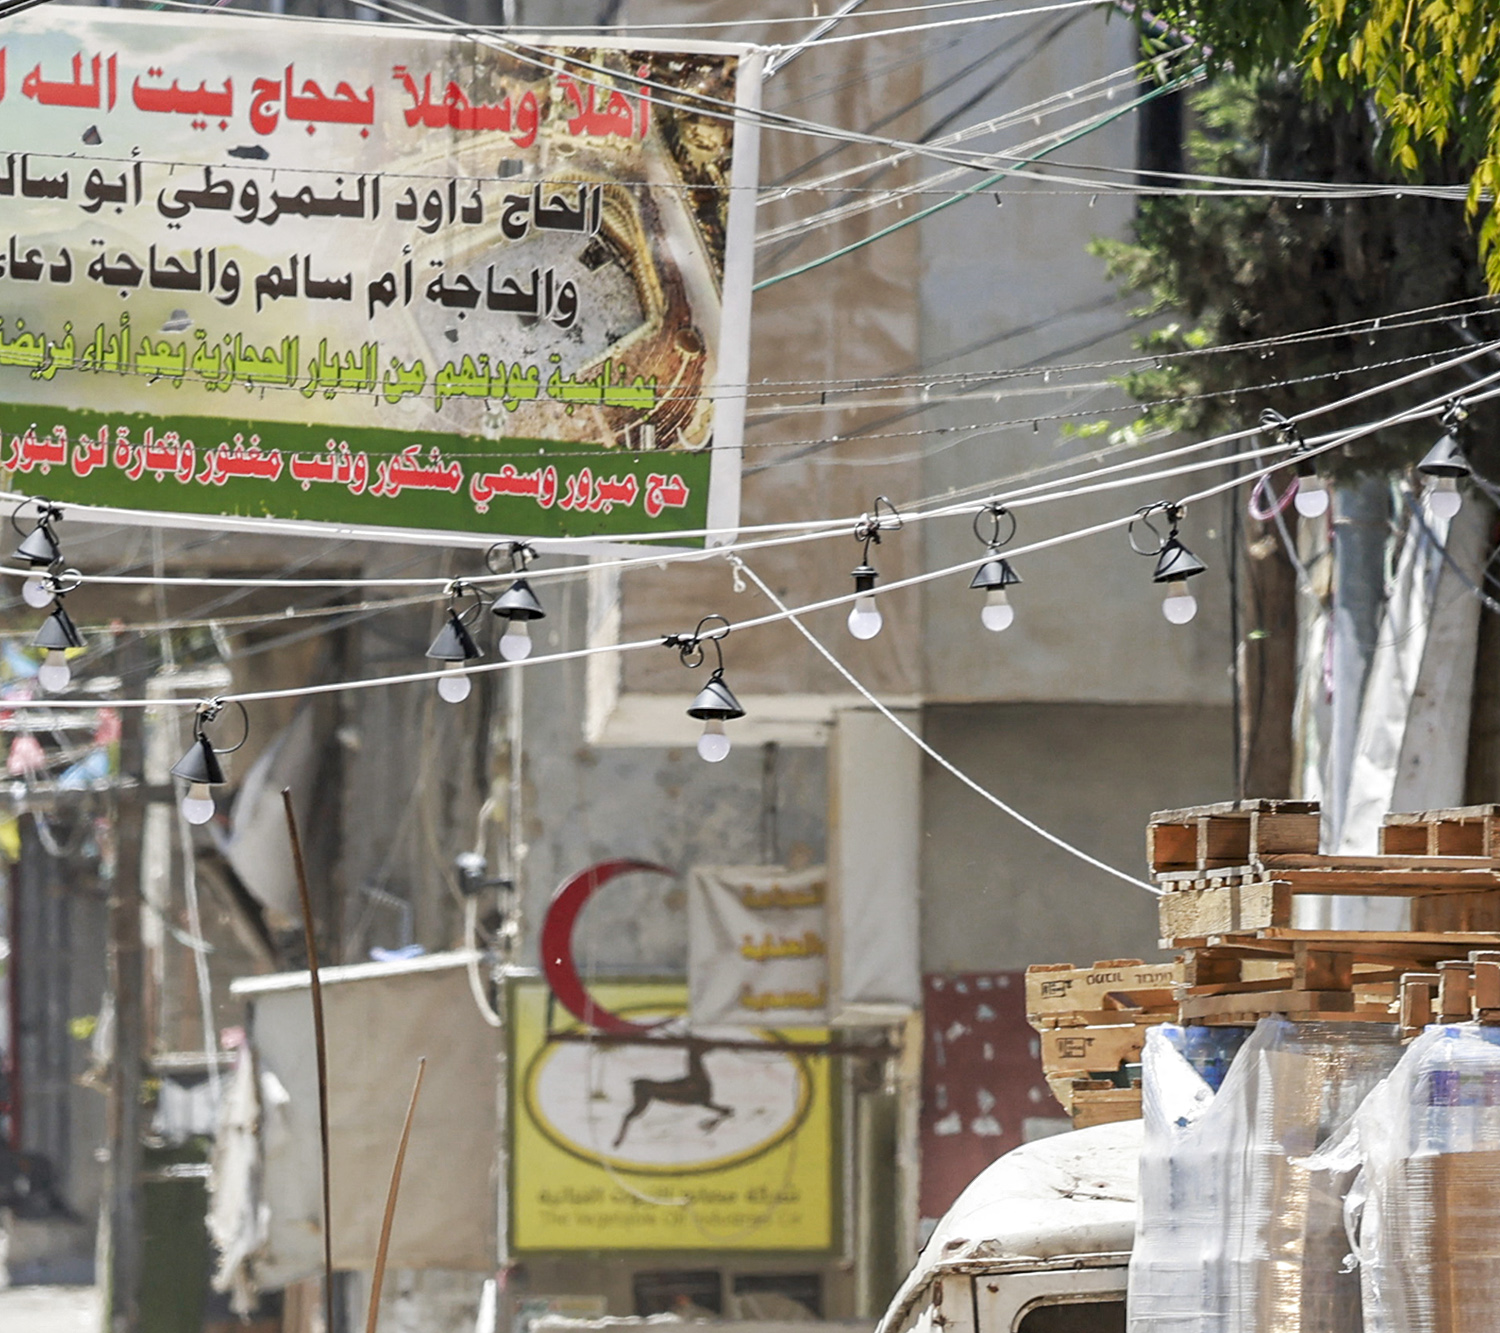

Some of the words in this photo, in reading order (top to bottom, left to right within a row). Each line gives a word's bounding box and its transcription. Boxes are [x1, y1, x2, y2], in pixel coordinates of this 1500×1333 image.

[20, 50, 118, 114] الله
[132, 65, 234, 132] بيت
[249, 62, 375, 139] بحجاج
[391, 64, 539, 148] وسهلاً
[78, 145, 143, 214] أبو
[156, 166, 384, 230] النمروطي
[501, 182, 602, 240] الحاج
[86, 238, 242, 306] والحاجة
[254, 253, 353, 313] سالم
[368, 244, 414, 321] أم
[424, 259, 580, 329] والحاجة
[76, 312, 132, 375] أداء
[135, 336, 188, 389] بعد
[191, 329, 300, 391] الحجازية
[300, 336, 378, 400] الديار
[382, 354, 428, 405] من
[434, 354, 539, 412] عودتهم
[546, 351, 658, 422] بمناسبة
[6, 424, 68, 475] تبور
[72, 425, 109, 478] لن
[115, 425, 196, 483] وتجارة
[197, 431, 285, 485] مغفور
[289, 437, 369, 497] وذنب
[370, 444, 464, 499] مشكور
[469, 463, 558, 514] وسعي
[559, 466, 639, 514] مبرور
[645, 471, 690, 519] حج
